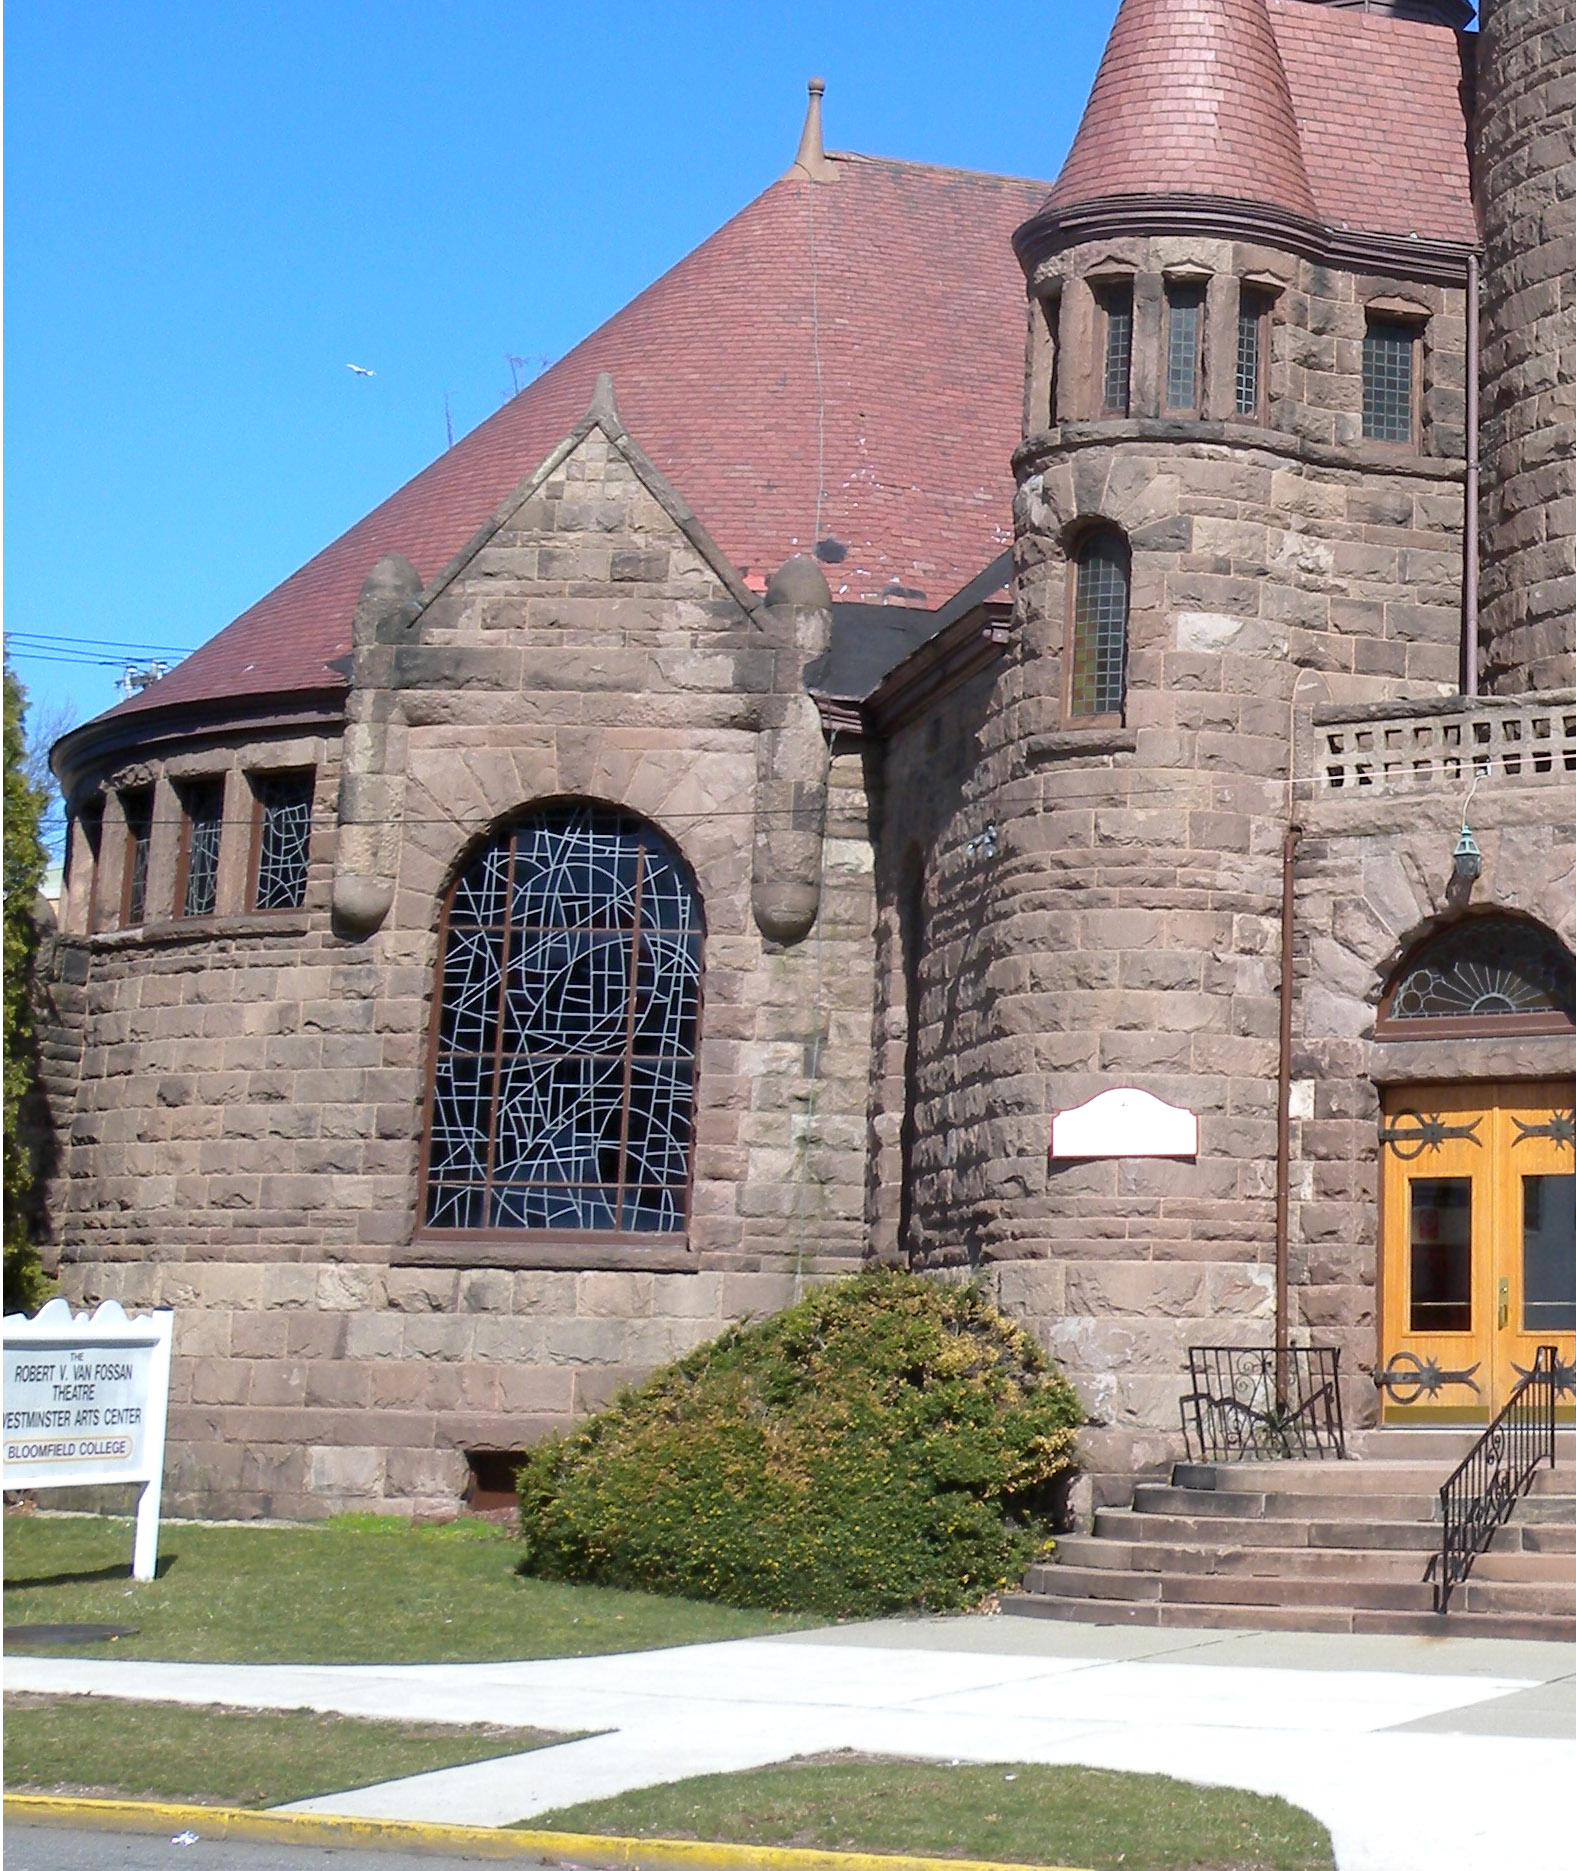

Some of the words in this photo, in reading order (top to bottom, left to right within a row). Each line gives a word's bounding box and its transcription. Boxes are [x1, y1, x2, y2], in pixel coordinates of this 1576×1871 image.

[70, 1352, 84, 1361] THE
[14, 1364, 56, 1382] ROBERT
[60, 1364, 68, 1381] V.
[74, 1364, 92, 1380] VAN
[94, 1363, 133, 1380] FOSSAN
[53, 1384, 95, 1401] THEATRE
[74, 1408, 100, 1426] ARTS
[104, 1407, 142, 1426] CENTER
[8, 1443, 76, 1459] BLOOMFIELD
[79, 1440, 126, 1456] COLLEGE
